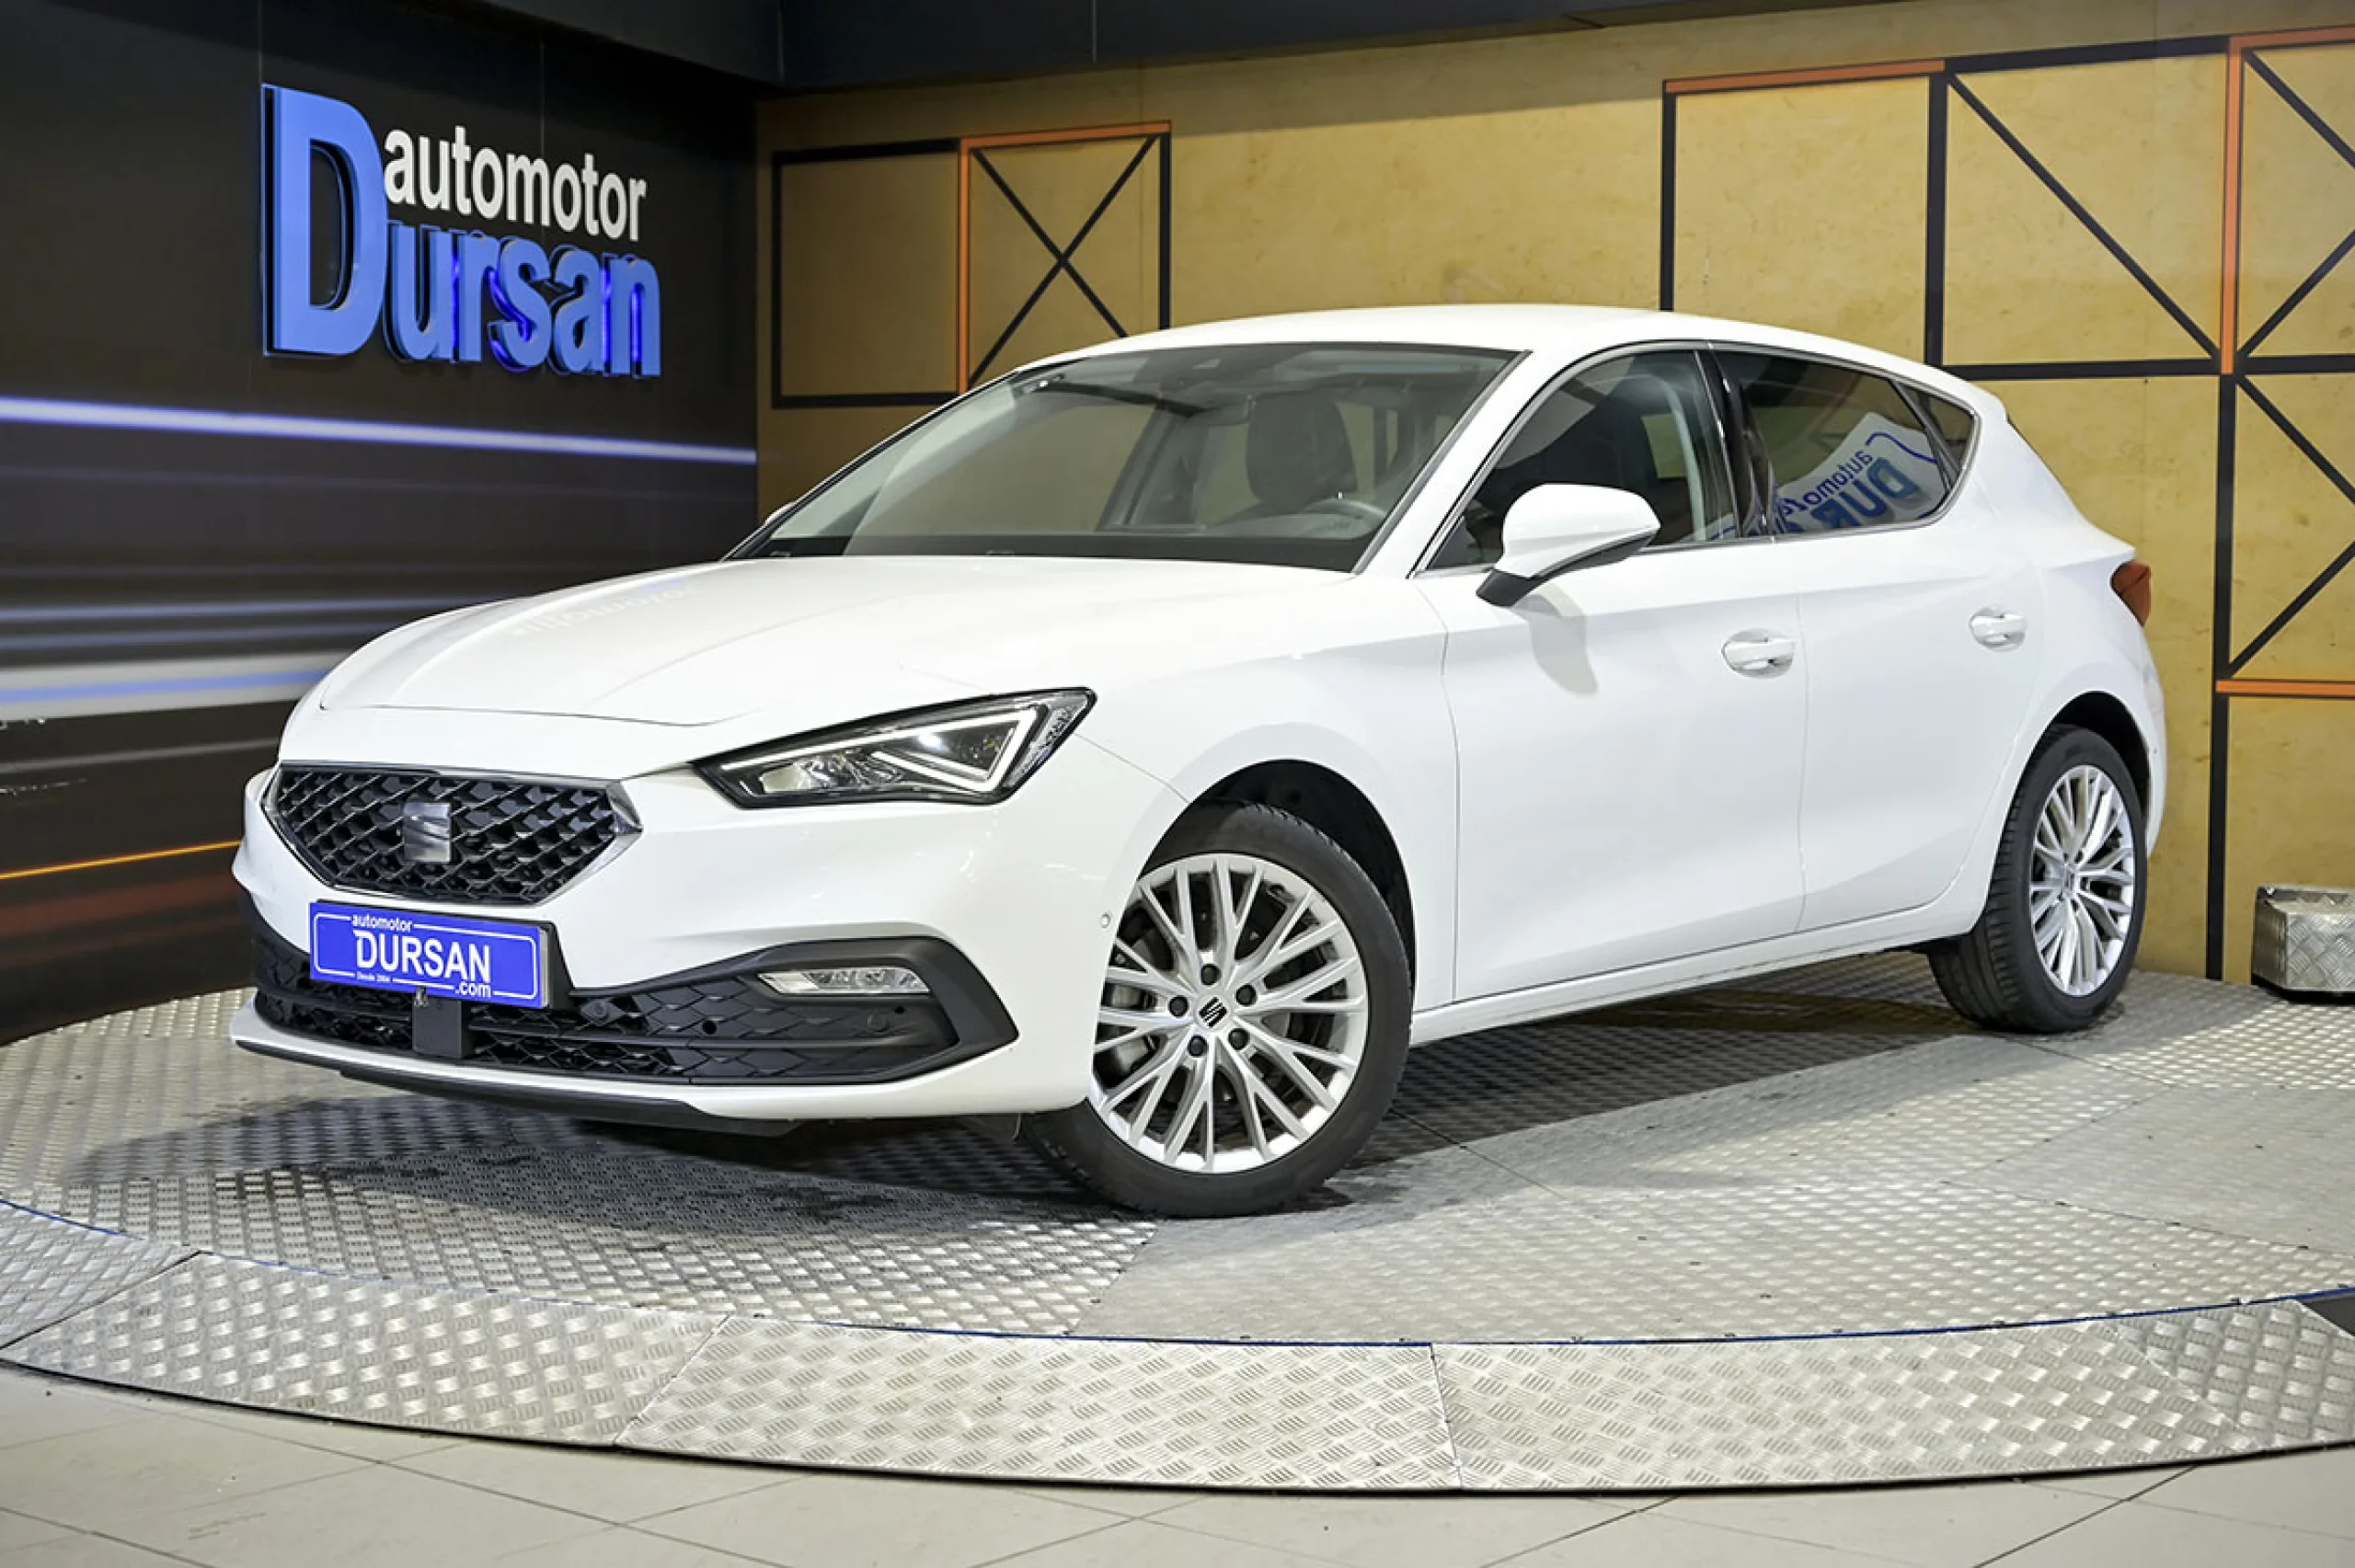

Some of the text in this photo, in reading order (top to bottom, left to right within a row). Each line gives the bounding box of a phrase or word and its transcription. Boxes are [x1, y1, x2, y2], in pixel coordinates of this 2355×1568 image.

[385, 126, 647, 241] automotor
[261, 83, 661, 377] Dursan
[352, 914, 413, 933] automotor
[353, 929, 491, 982] DURSAN
[454, 981, 491, 998] .com
